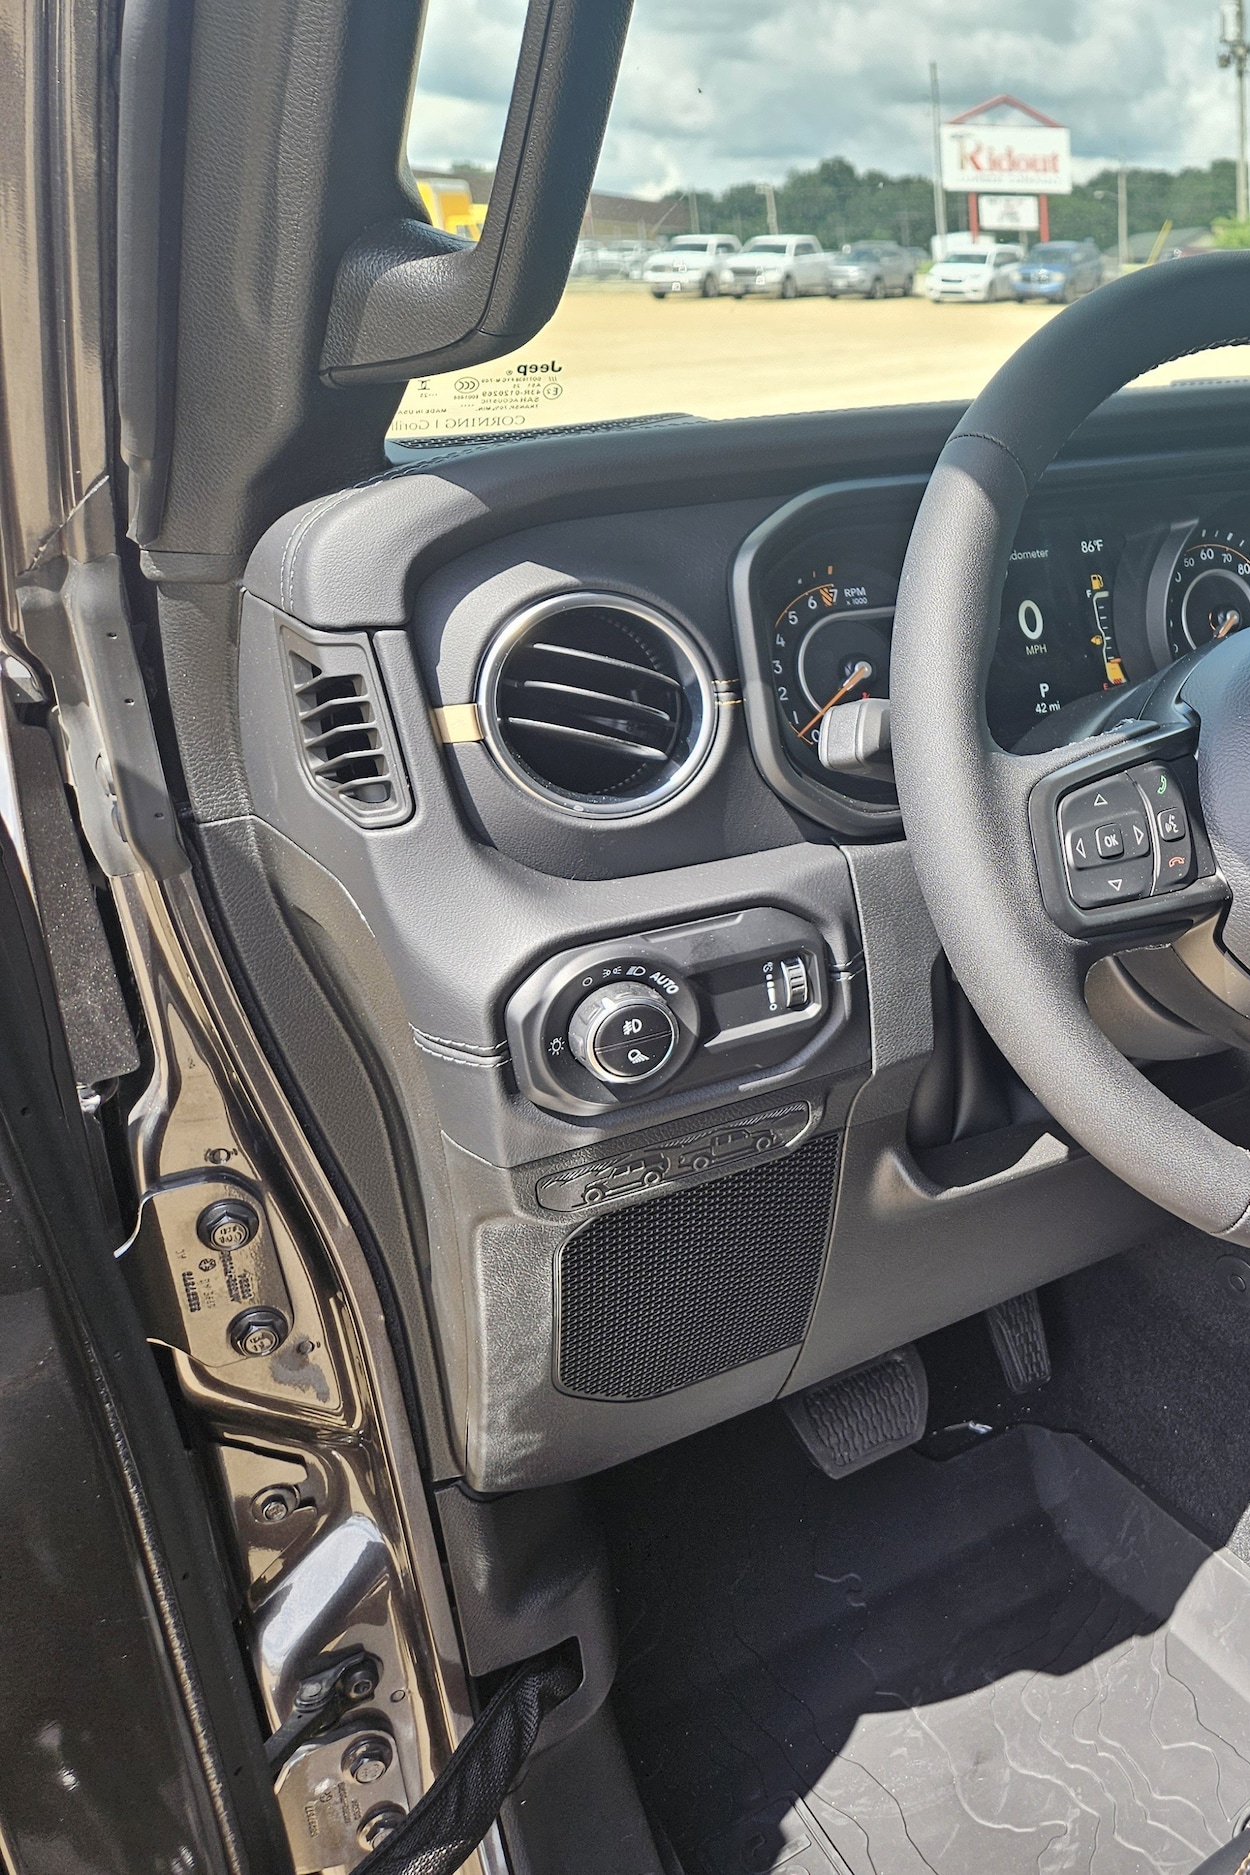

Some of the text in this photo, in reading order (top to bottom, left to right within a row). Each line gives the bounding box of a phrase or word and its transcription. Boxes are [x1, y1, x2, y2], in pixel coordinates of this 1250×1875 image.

[1009, 549, 1049, 561] dometer
[1200, 547, 1214, 561] 60
[1221, 552, 1233, 564] 70
[1184, 557, 1195, 568] 50
[1237, 563, 1250, 576] 80
[829, 589, 839, 602] 7
[844, 587, 867, 597] RPM
[1086, 590, 1092, 598] F
[808, 596, 817, 609] 6
[852, 597, 868, 605] 1000
[788, 611, 798, 624] 5
[1018, 600, 1044, 640] 0
[776, 634, 785, 647] 4
[1026, 643, 1047, 656] MPH
[773, 660, 783, 673] 3
[778, 688, 788, 700] 2
[1039, 683, 1049, 698] P
[1035, 700, 1061, 713] 42 mi
[792, 711, 799, 724] 1
[1104, 834, 1119, 848] OK
[649, 970, 679, 995] AUTO
